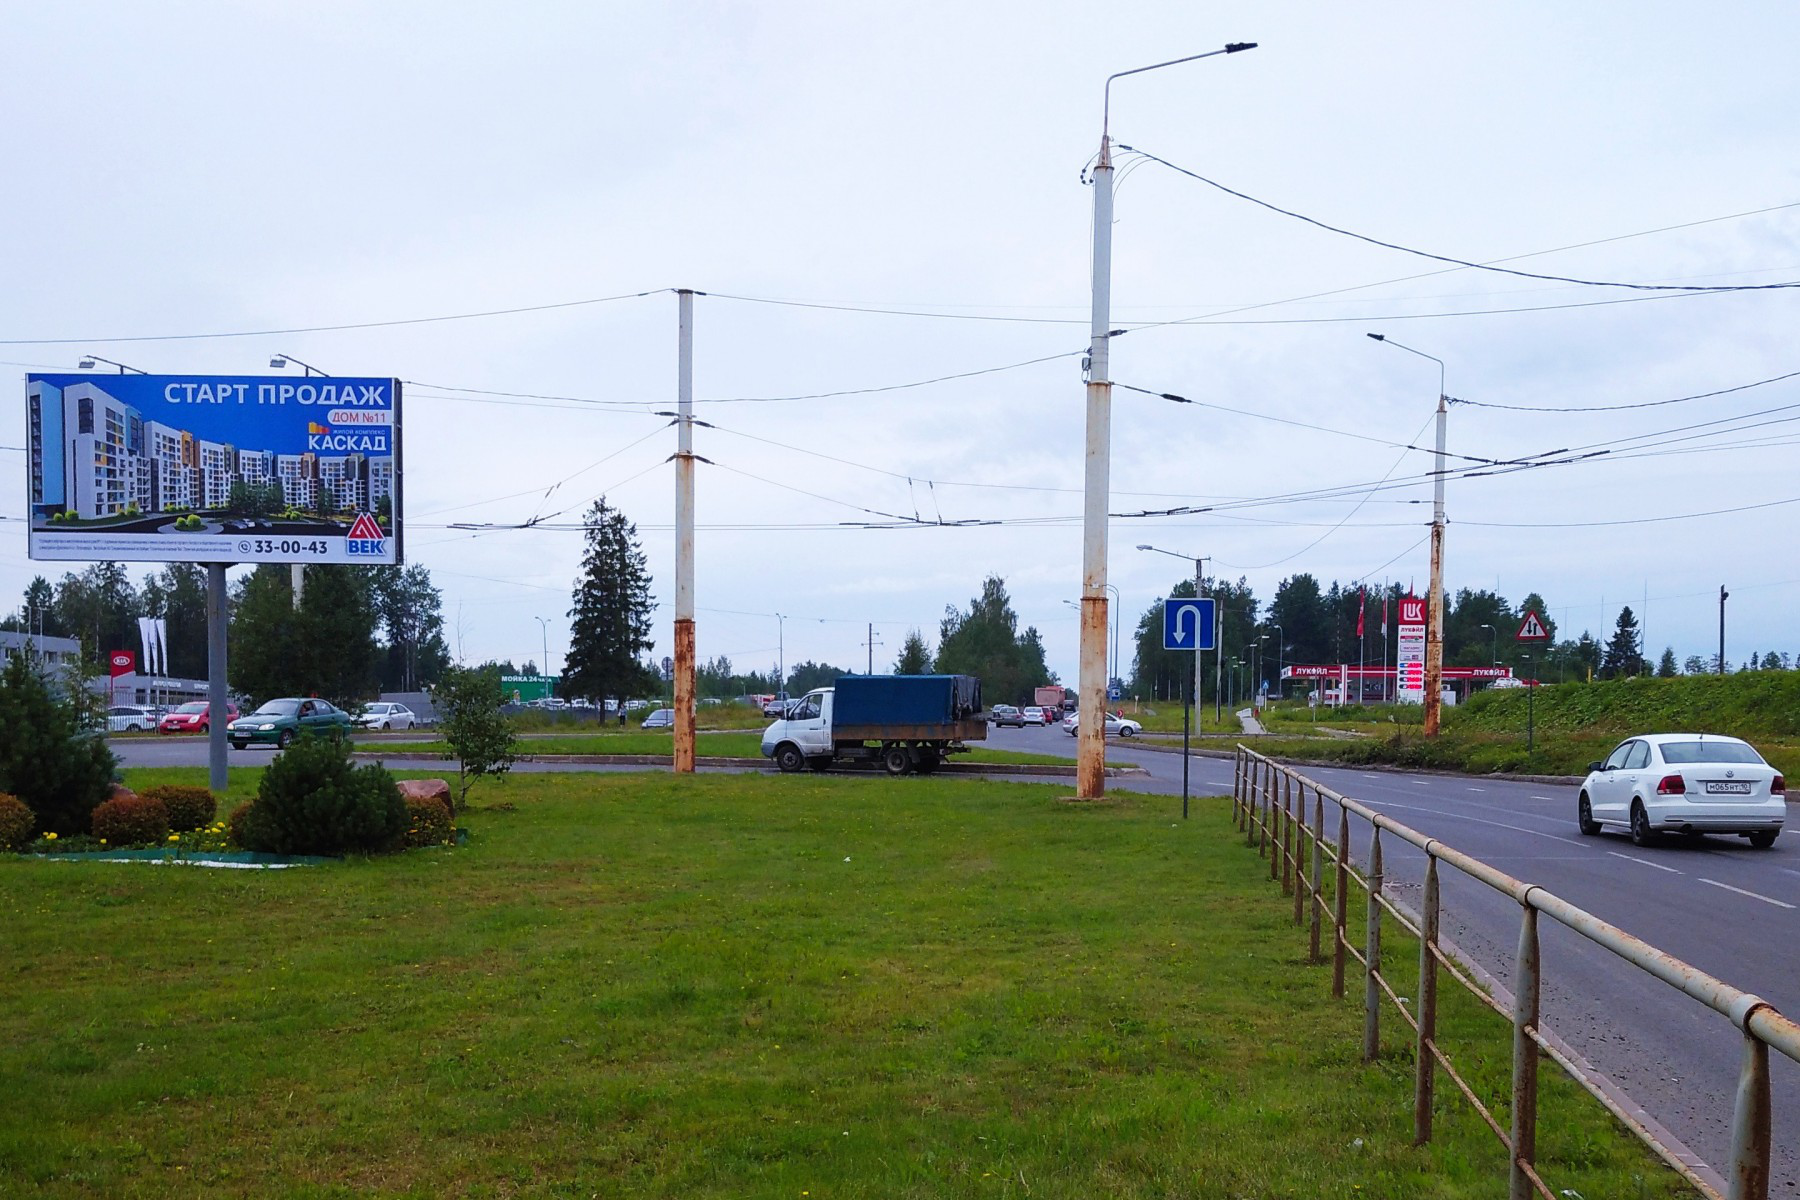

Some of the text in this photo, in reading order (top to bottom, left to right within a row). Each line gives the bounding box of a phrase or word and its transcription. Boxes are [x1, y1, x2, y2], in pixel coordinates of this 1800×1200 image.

[164, 383, 385, 406] СТАРТ ПРОДАЖ
[332, 412, 386, 423] ДОМ №11
[308, 435, 387, 451] КАСКАД
[254, 540, 328, 554] 33-00-43
[348, 540, 383, 554] ВЕК
[1296, 667, 1328, 675] ЛУКОЙЛ
[1473, 668, 1506, 676] ЛУКОЙЛ
